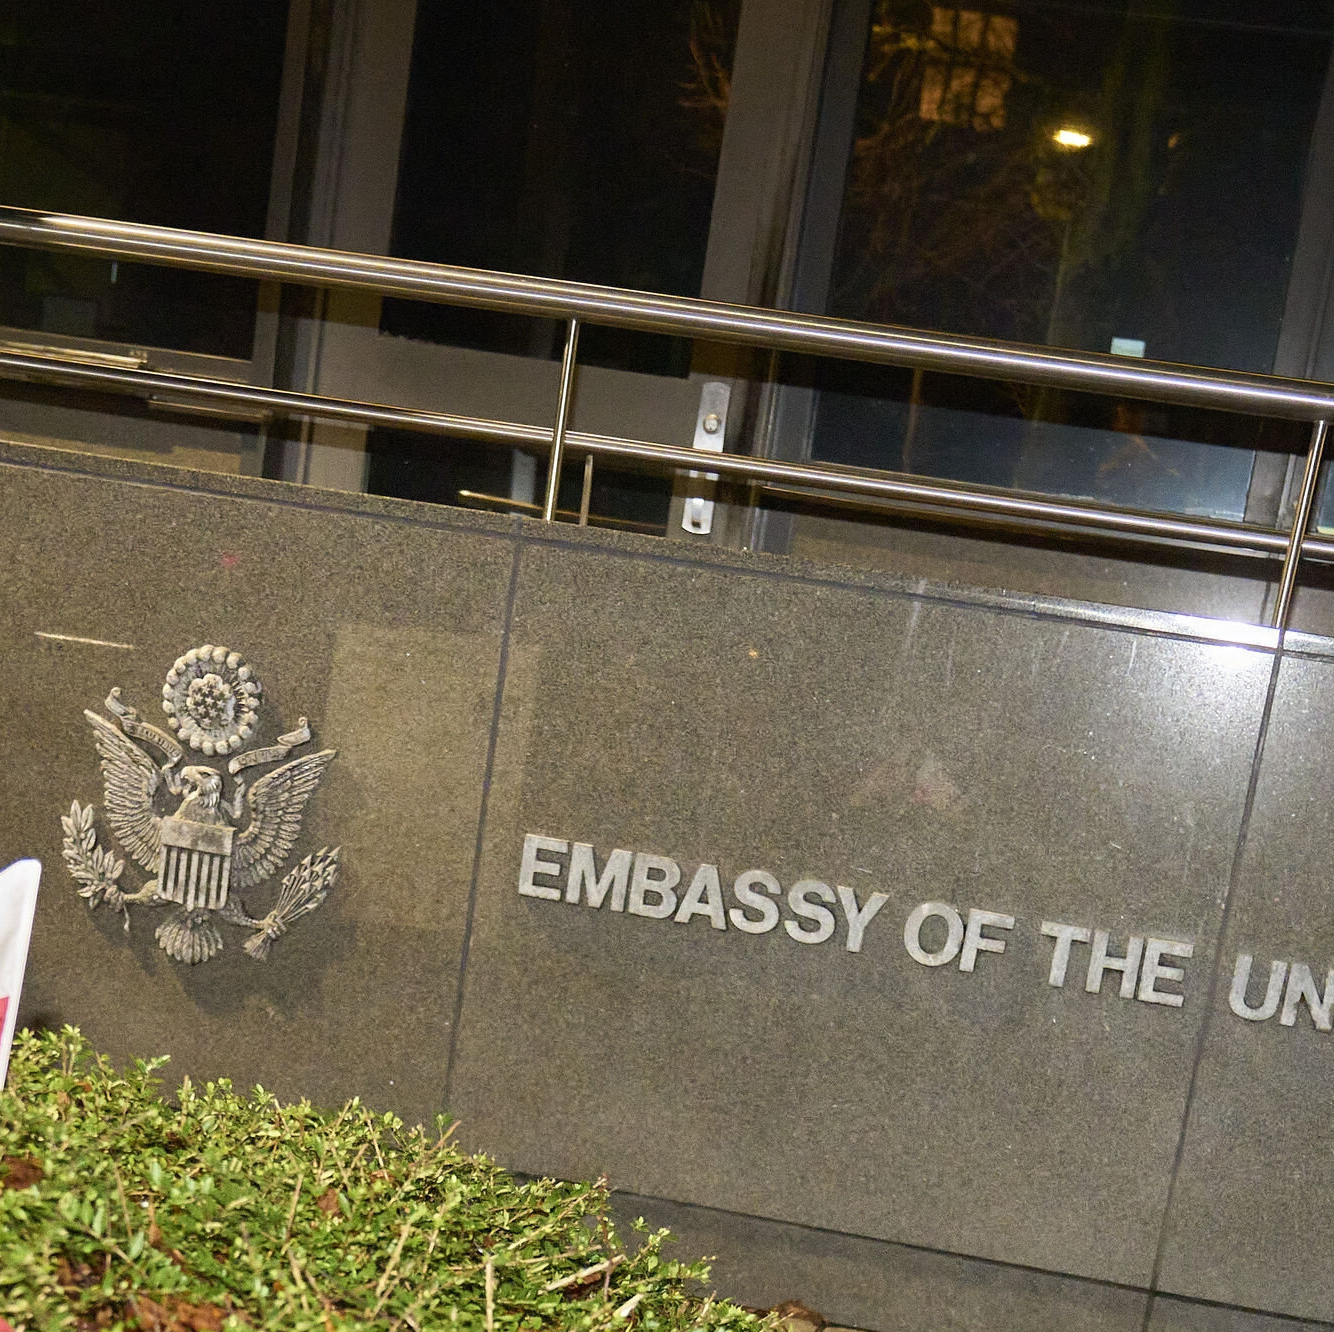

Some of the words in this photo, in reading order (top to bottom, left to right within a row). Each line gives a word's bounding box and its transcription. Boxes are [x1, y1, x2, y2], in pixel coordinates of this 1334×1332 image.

[518, 833, 889, 953] EMBASSY
[903, 902, 1015, 973] OF
[1040, 920, 1195, 1008] THE
